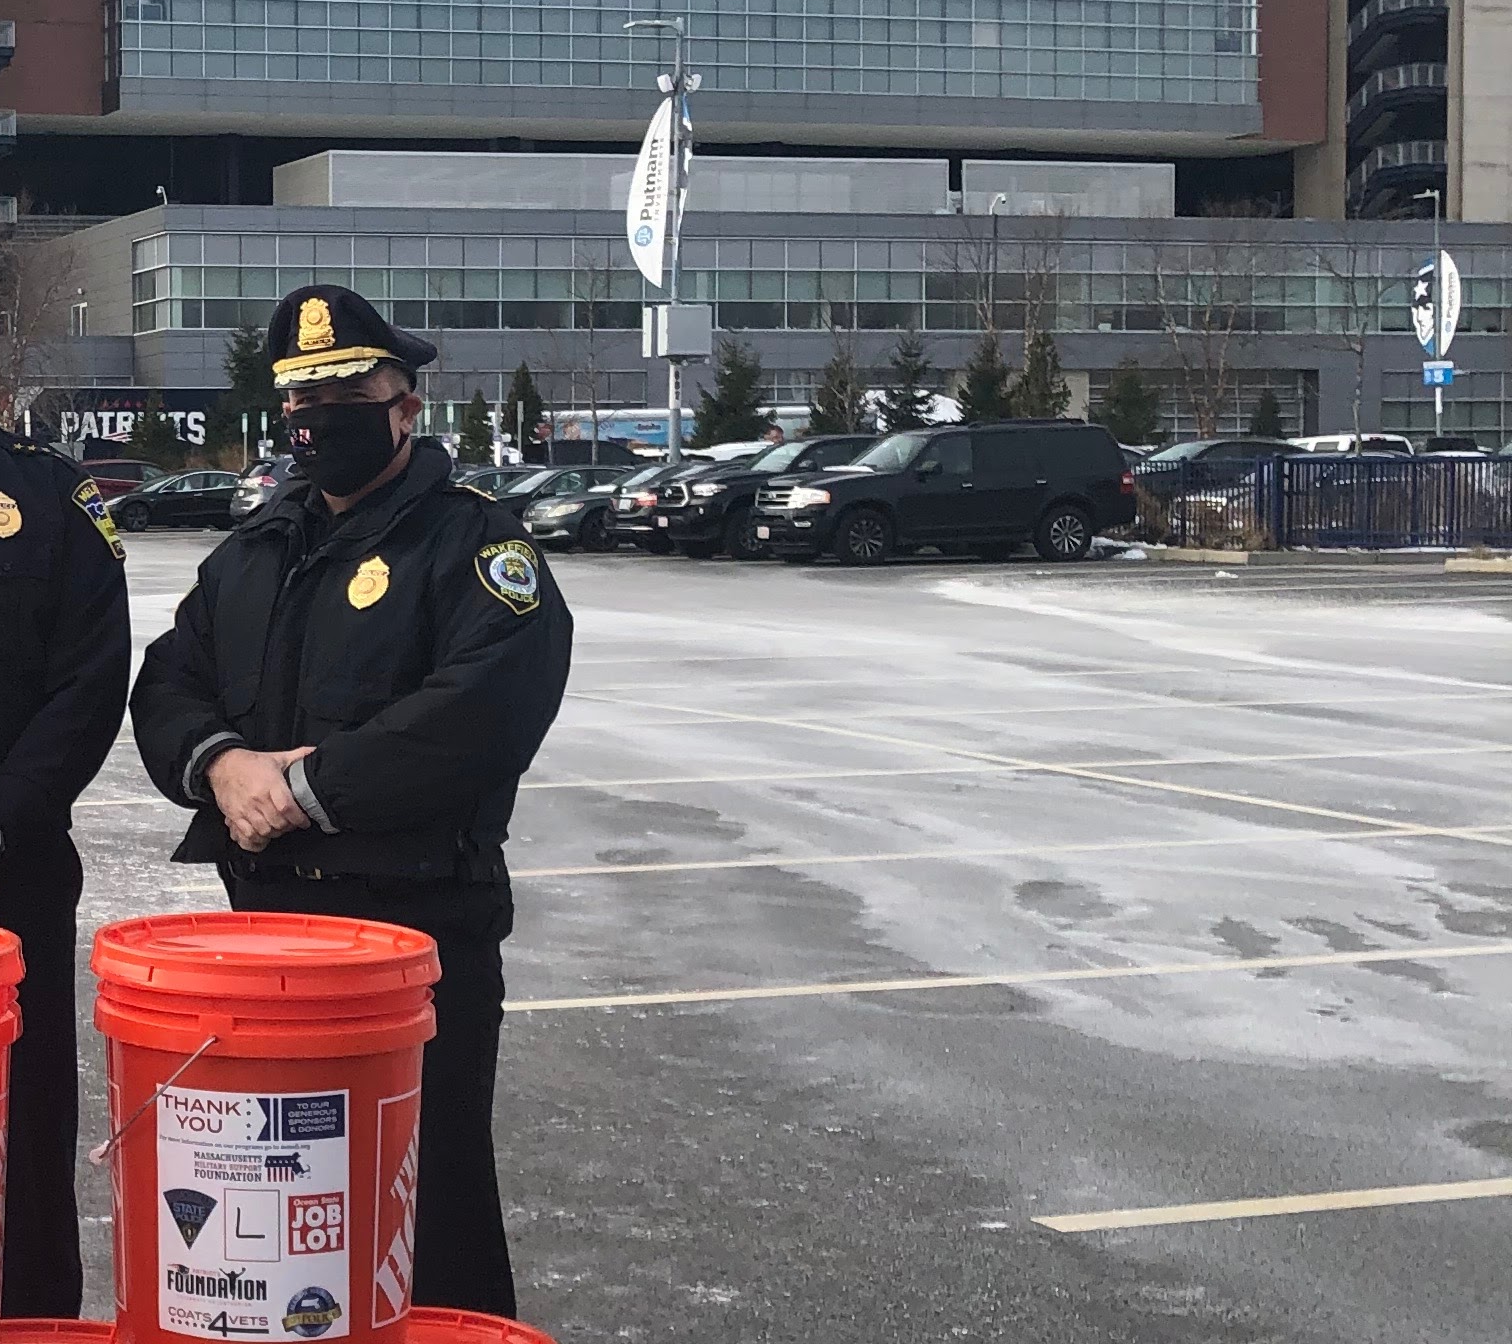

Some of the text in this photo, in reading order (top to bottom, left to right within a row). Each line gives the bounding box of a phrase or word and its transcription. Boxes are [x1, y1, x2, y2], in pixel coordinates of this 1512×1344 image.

[640, 139, 659, 221] Putnam
[161, 1094, 242, 1116] THANK
[176, 1114, 223, 1133] YOU
[194, 1151, 262, 1163] MASSACHUSETTS
[194, 1169, 262, 1182] FOUNDATION
[236, 1207, 265, 1239] L
[292, 1204, 342, 1228] JOB
[292, 1226, 341, 1251] LOT
